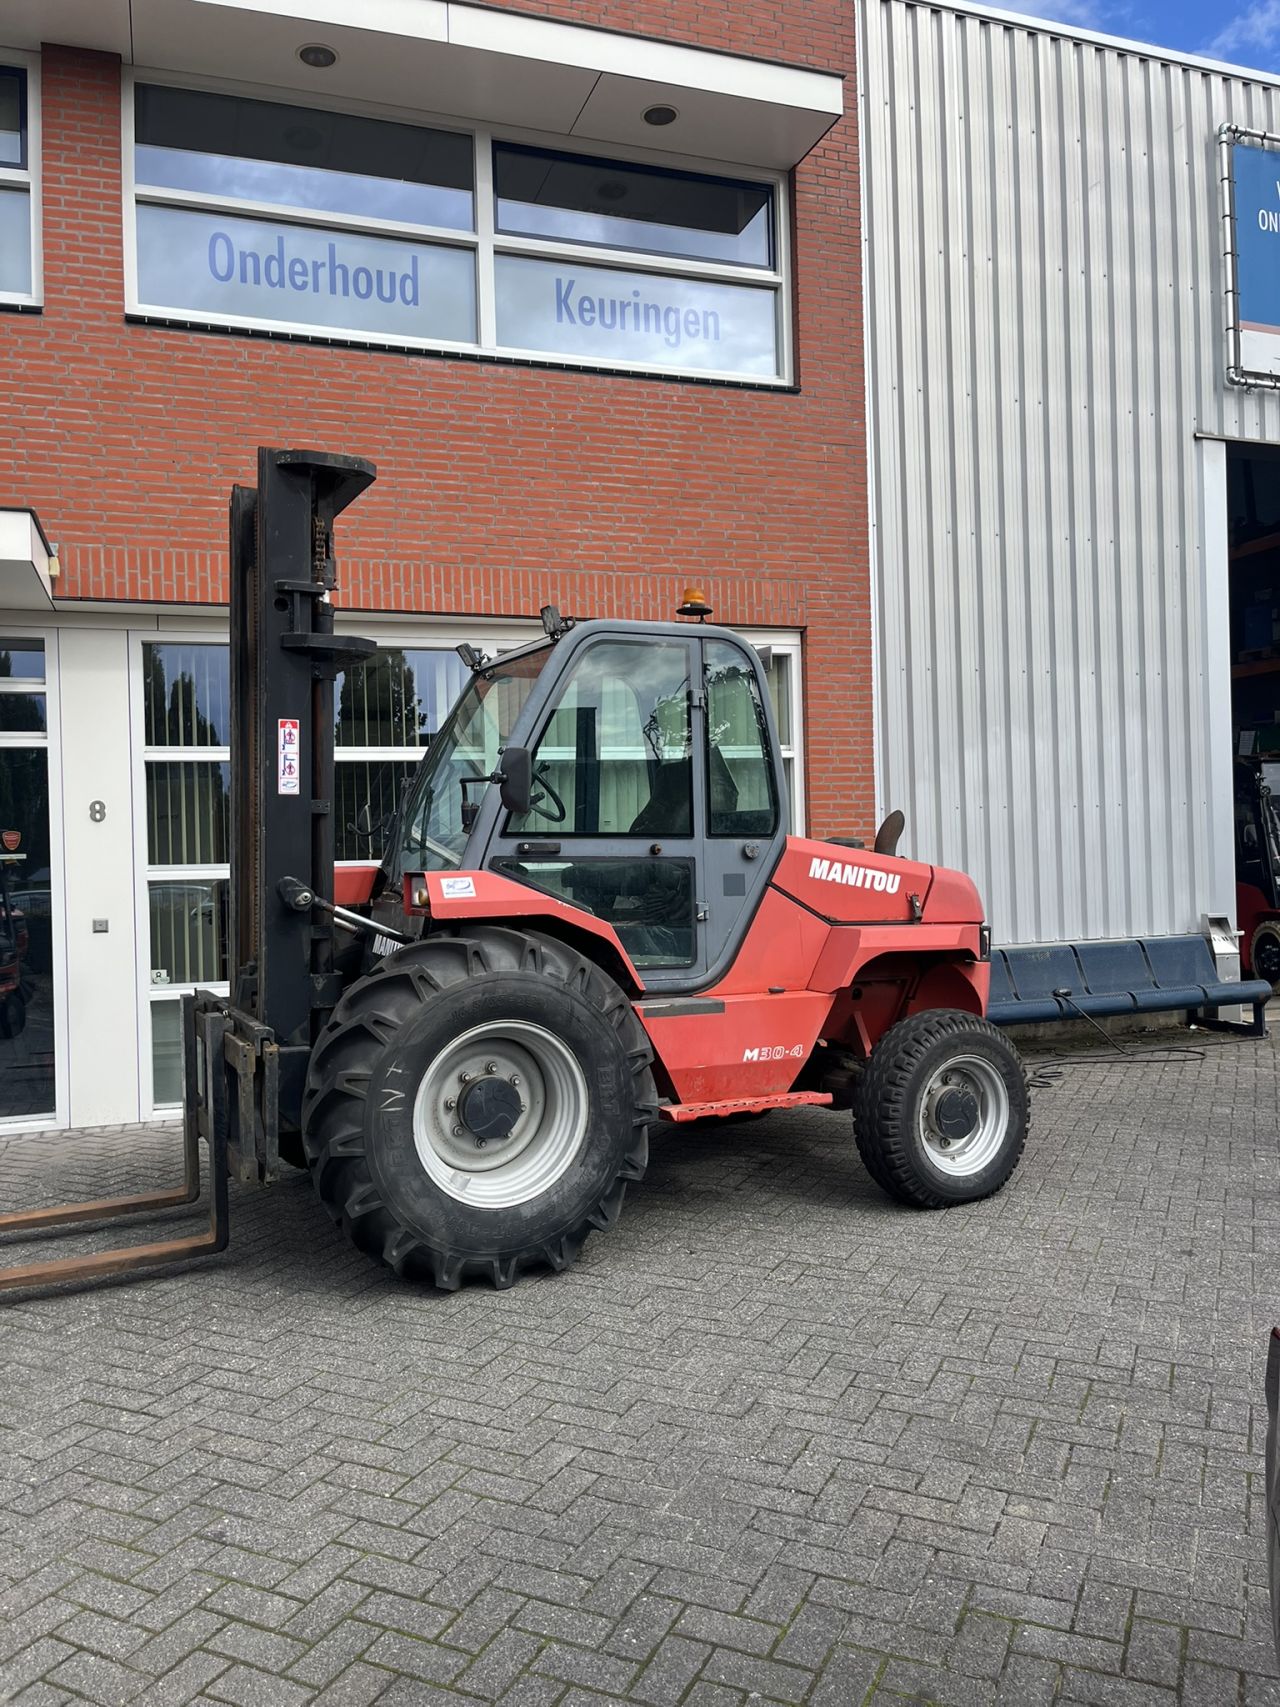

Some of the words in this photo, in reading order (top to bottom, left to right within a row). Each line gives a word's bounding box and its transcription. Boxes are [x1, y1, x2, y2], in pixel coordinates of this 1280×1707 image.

[1258, 209, 1280, 234] ON
[208, 231, 419, 306] Onderhoud
[555, 278, 720, 348] Keuringen
[90, 800, 106, 823] 8
[808, 857, 901, 894] MANITOU
[743, 1044, 803, 1062] M30-4
